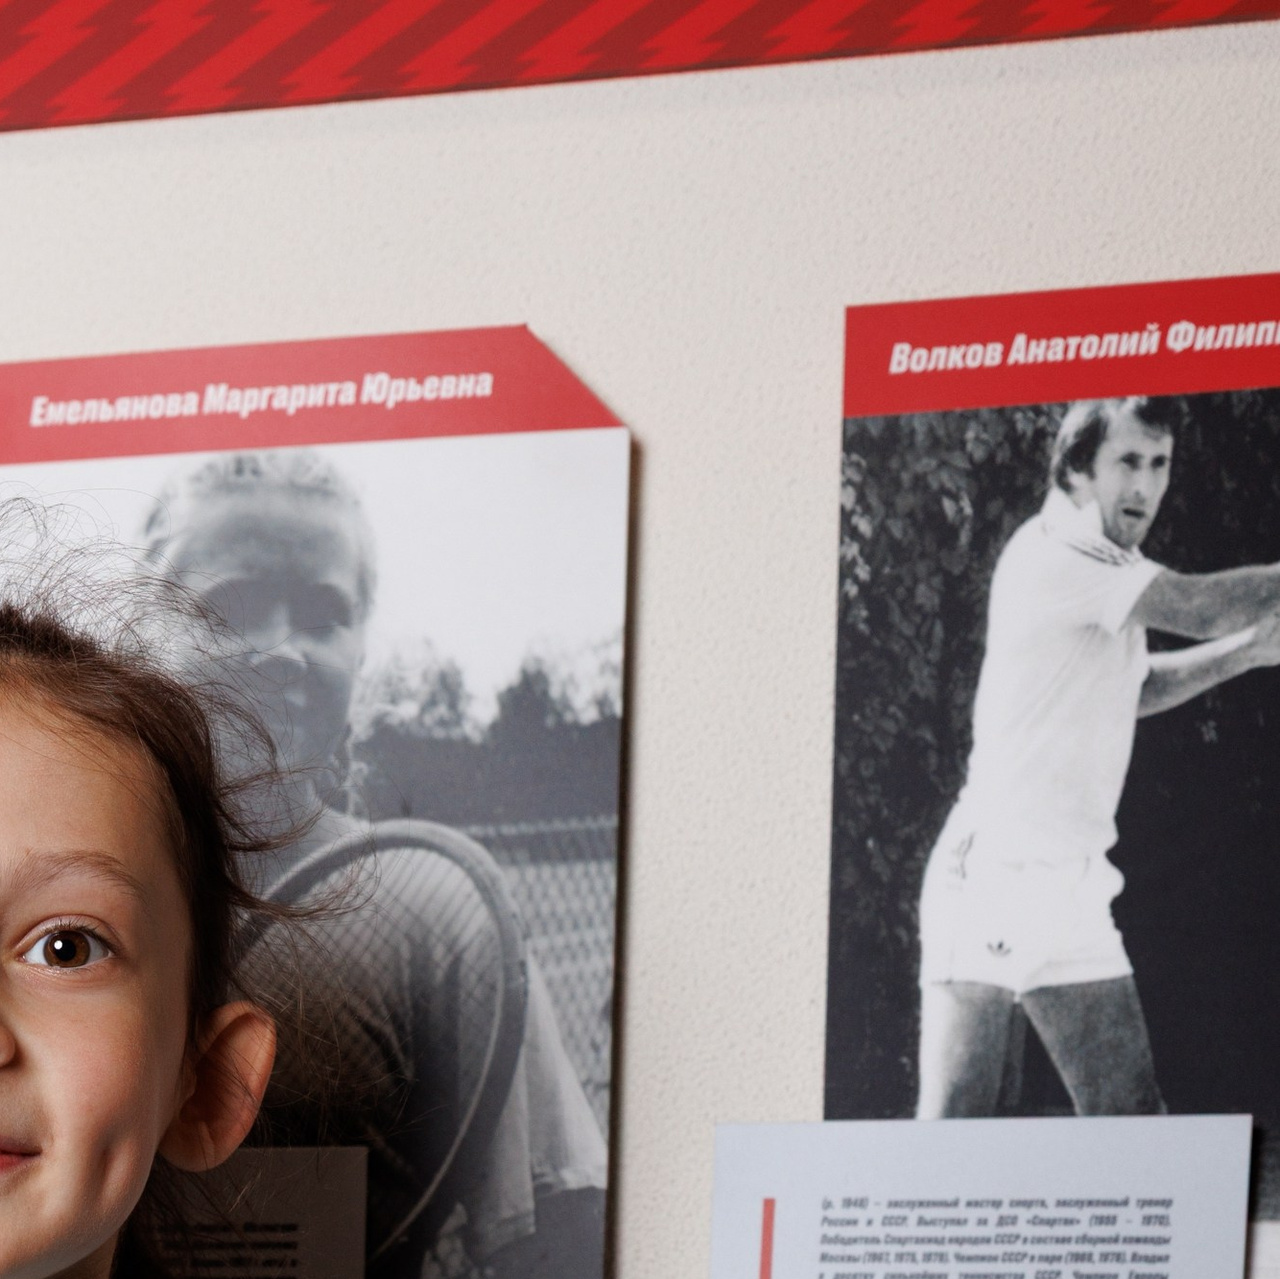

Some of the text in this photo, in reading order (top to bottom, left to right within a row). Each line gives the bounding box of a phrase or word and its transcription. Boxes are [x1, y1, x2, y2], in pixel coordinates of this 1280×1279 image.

[888, 320, 1280, 374] Волков Анатолий Филип
[29, 371, 494, 428] Емельянова Маргарита Юрьевна
